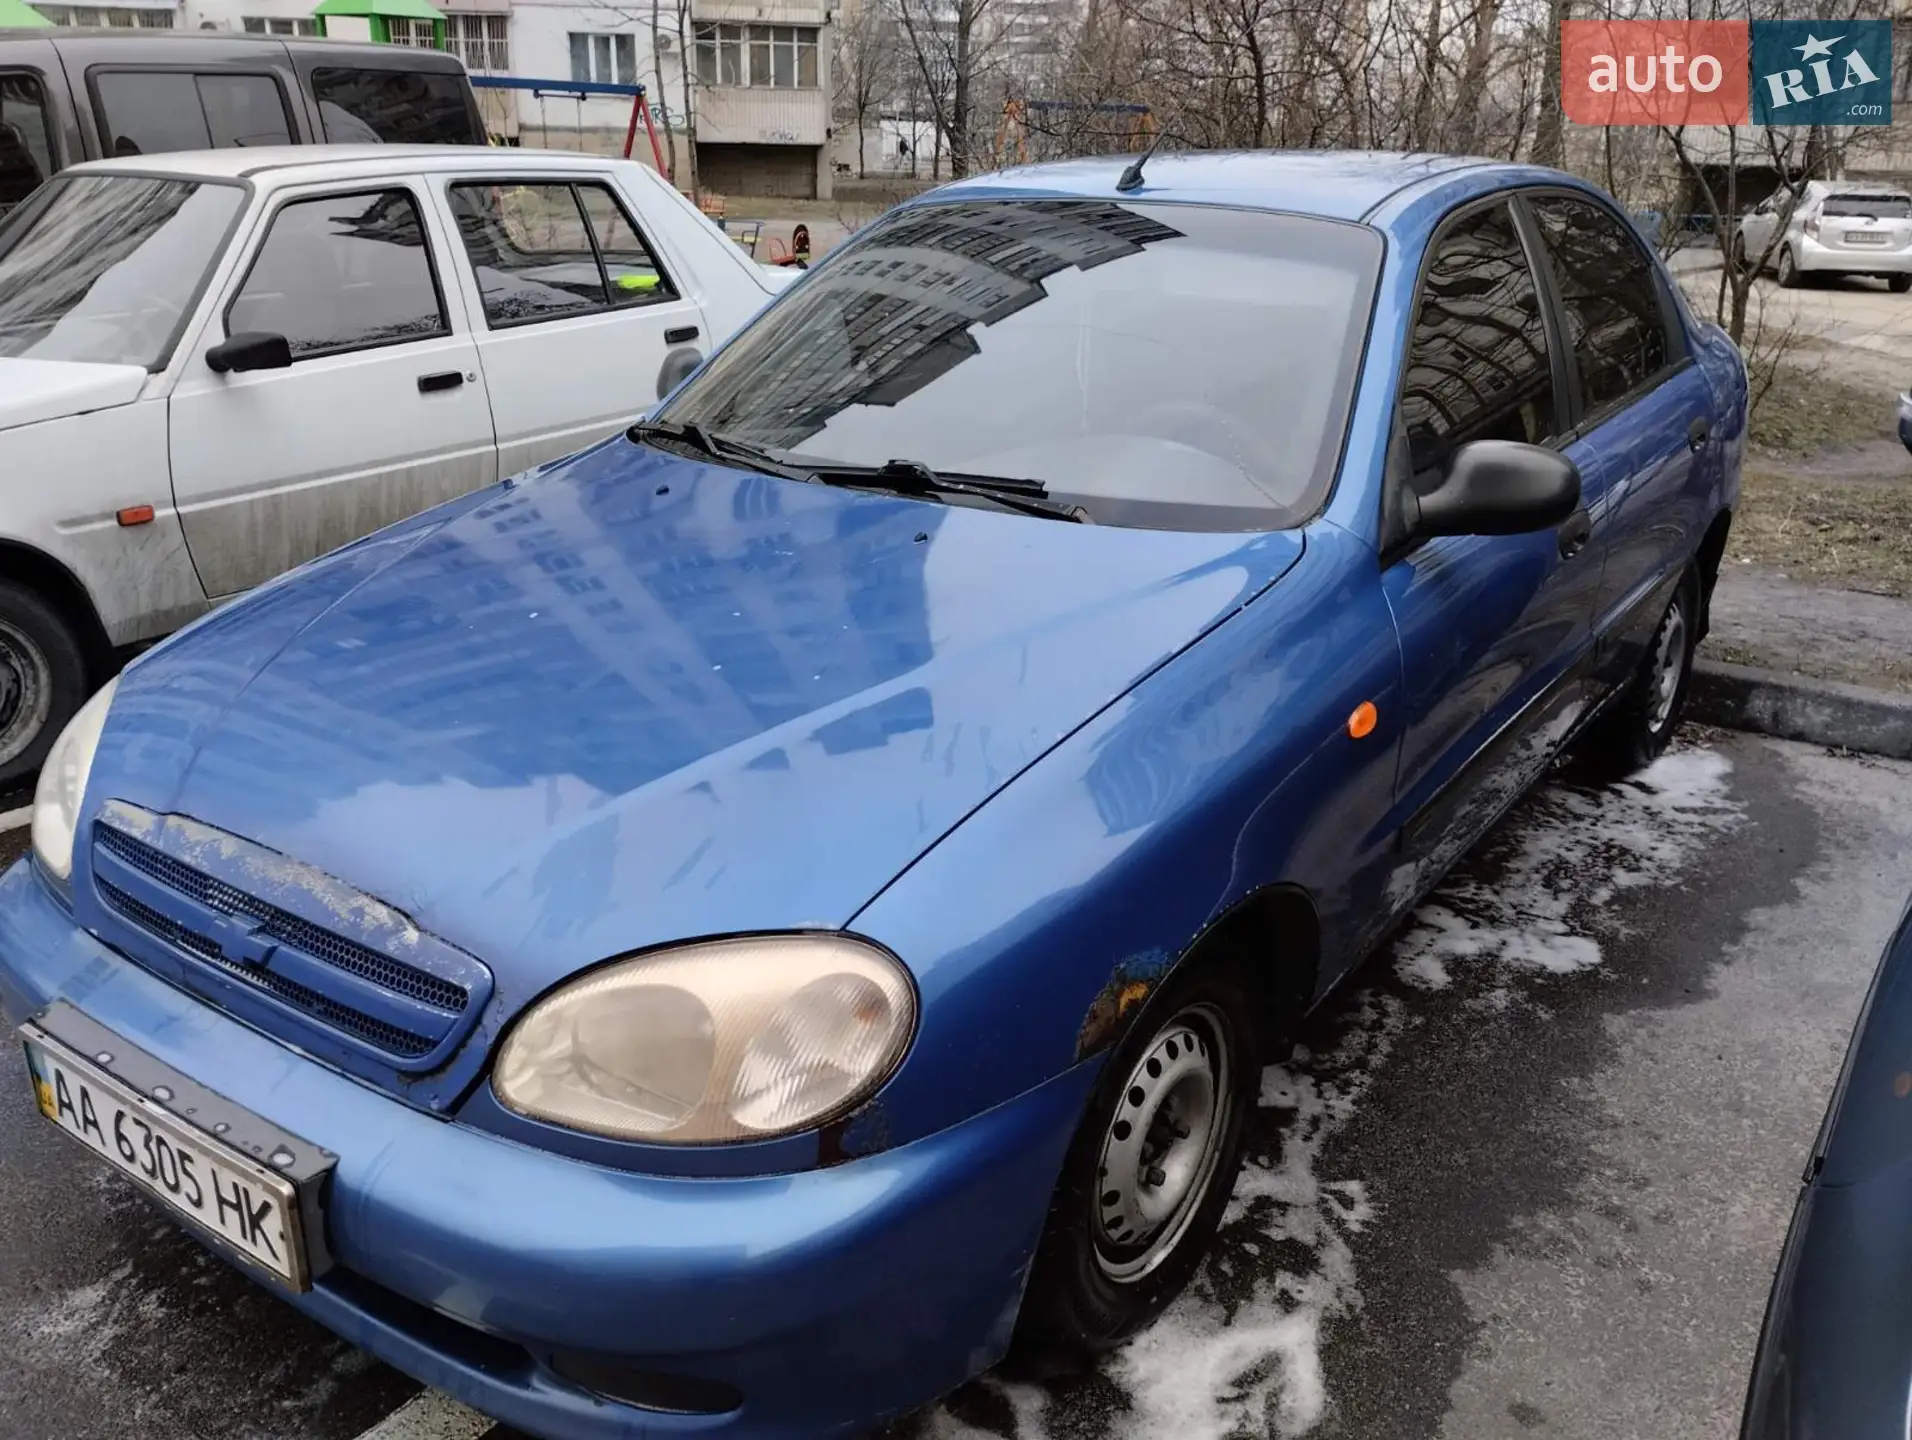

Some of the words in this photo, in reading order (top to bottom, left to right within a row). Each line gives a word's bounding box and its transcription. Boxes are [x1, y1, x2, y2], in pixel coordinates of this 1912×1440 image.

[54, 1067, 106, 1147] AA
[114, 1109, 203, 1210] 6305
[212, 1167, 281, 1262] HK
